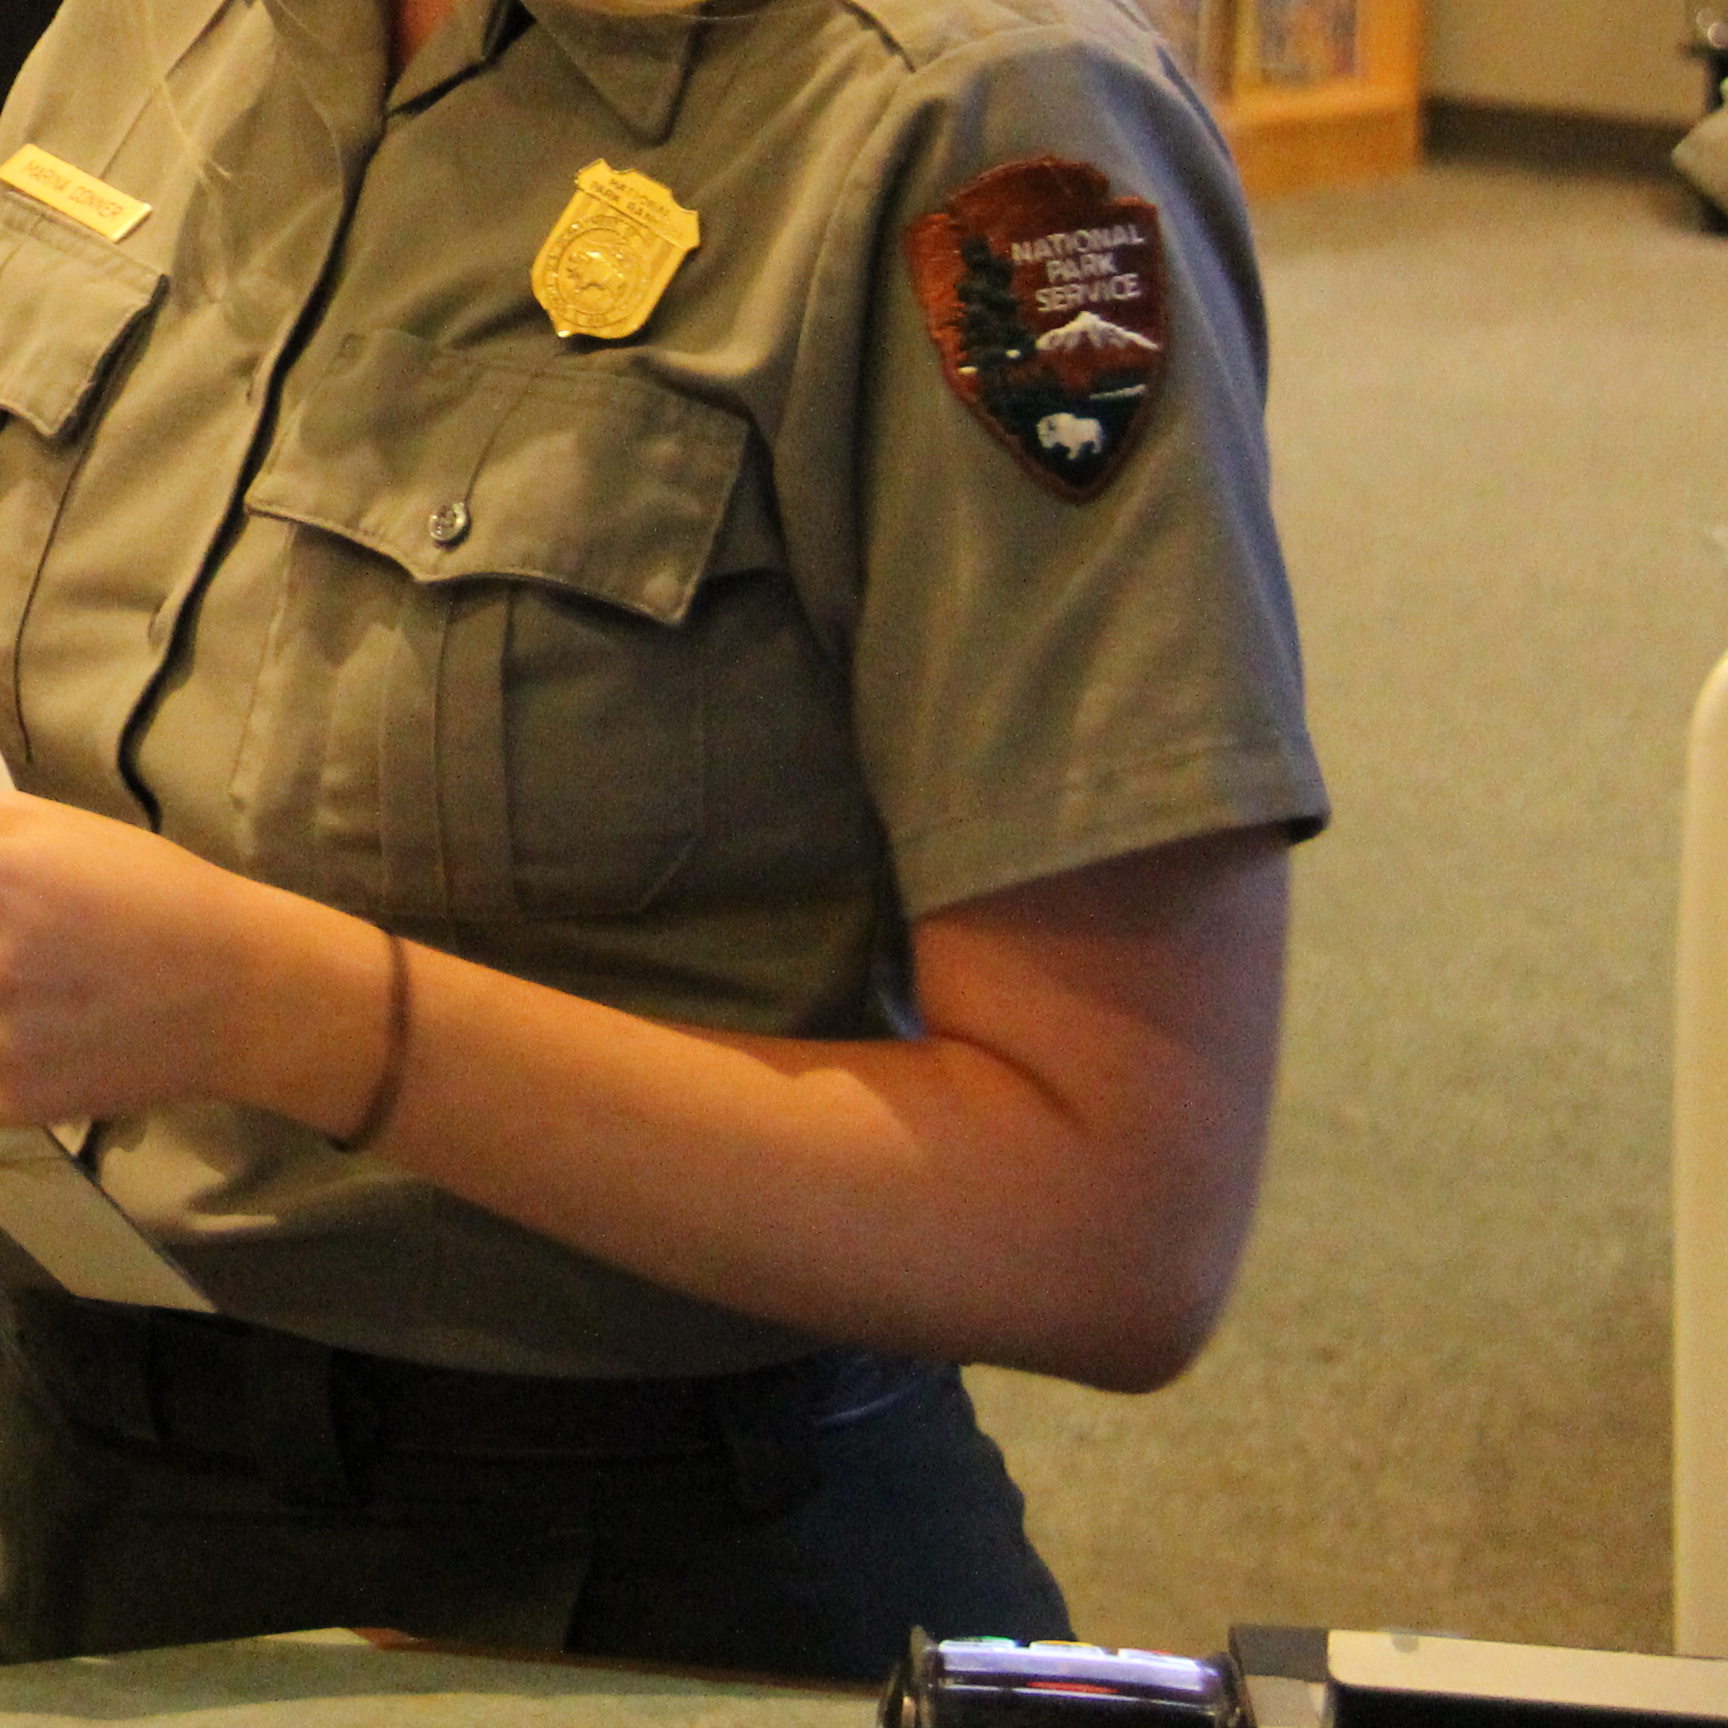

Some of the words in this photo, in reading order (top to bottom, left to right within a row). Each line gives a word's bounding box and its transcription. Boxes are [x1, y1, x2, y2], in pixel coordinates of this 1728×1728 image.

[1011, 224, 1145, 266] NATIONAL
[1047, 252, 1118, 283] PARK
[1035, 273, 1142, 312] SERVICE
